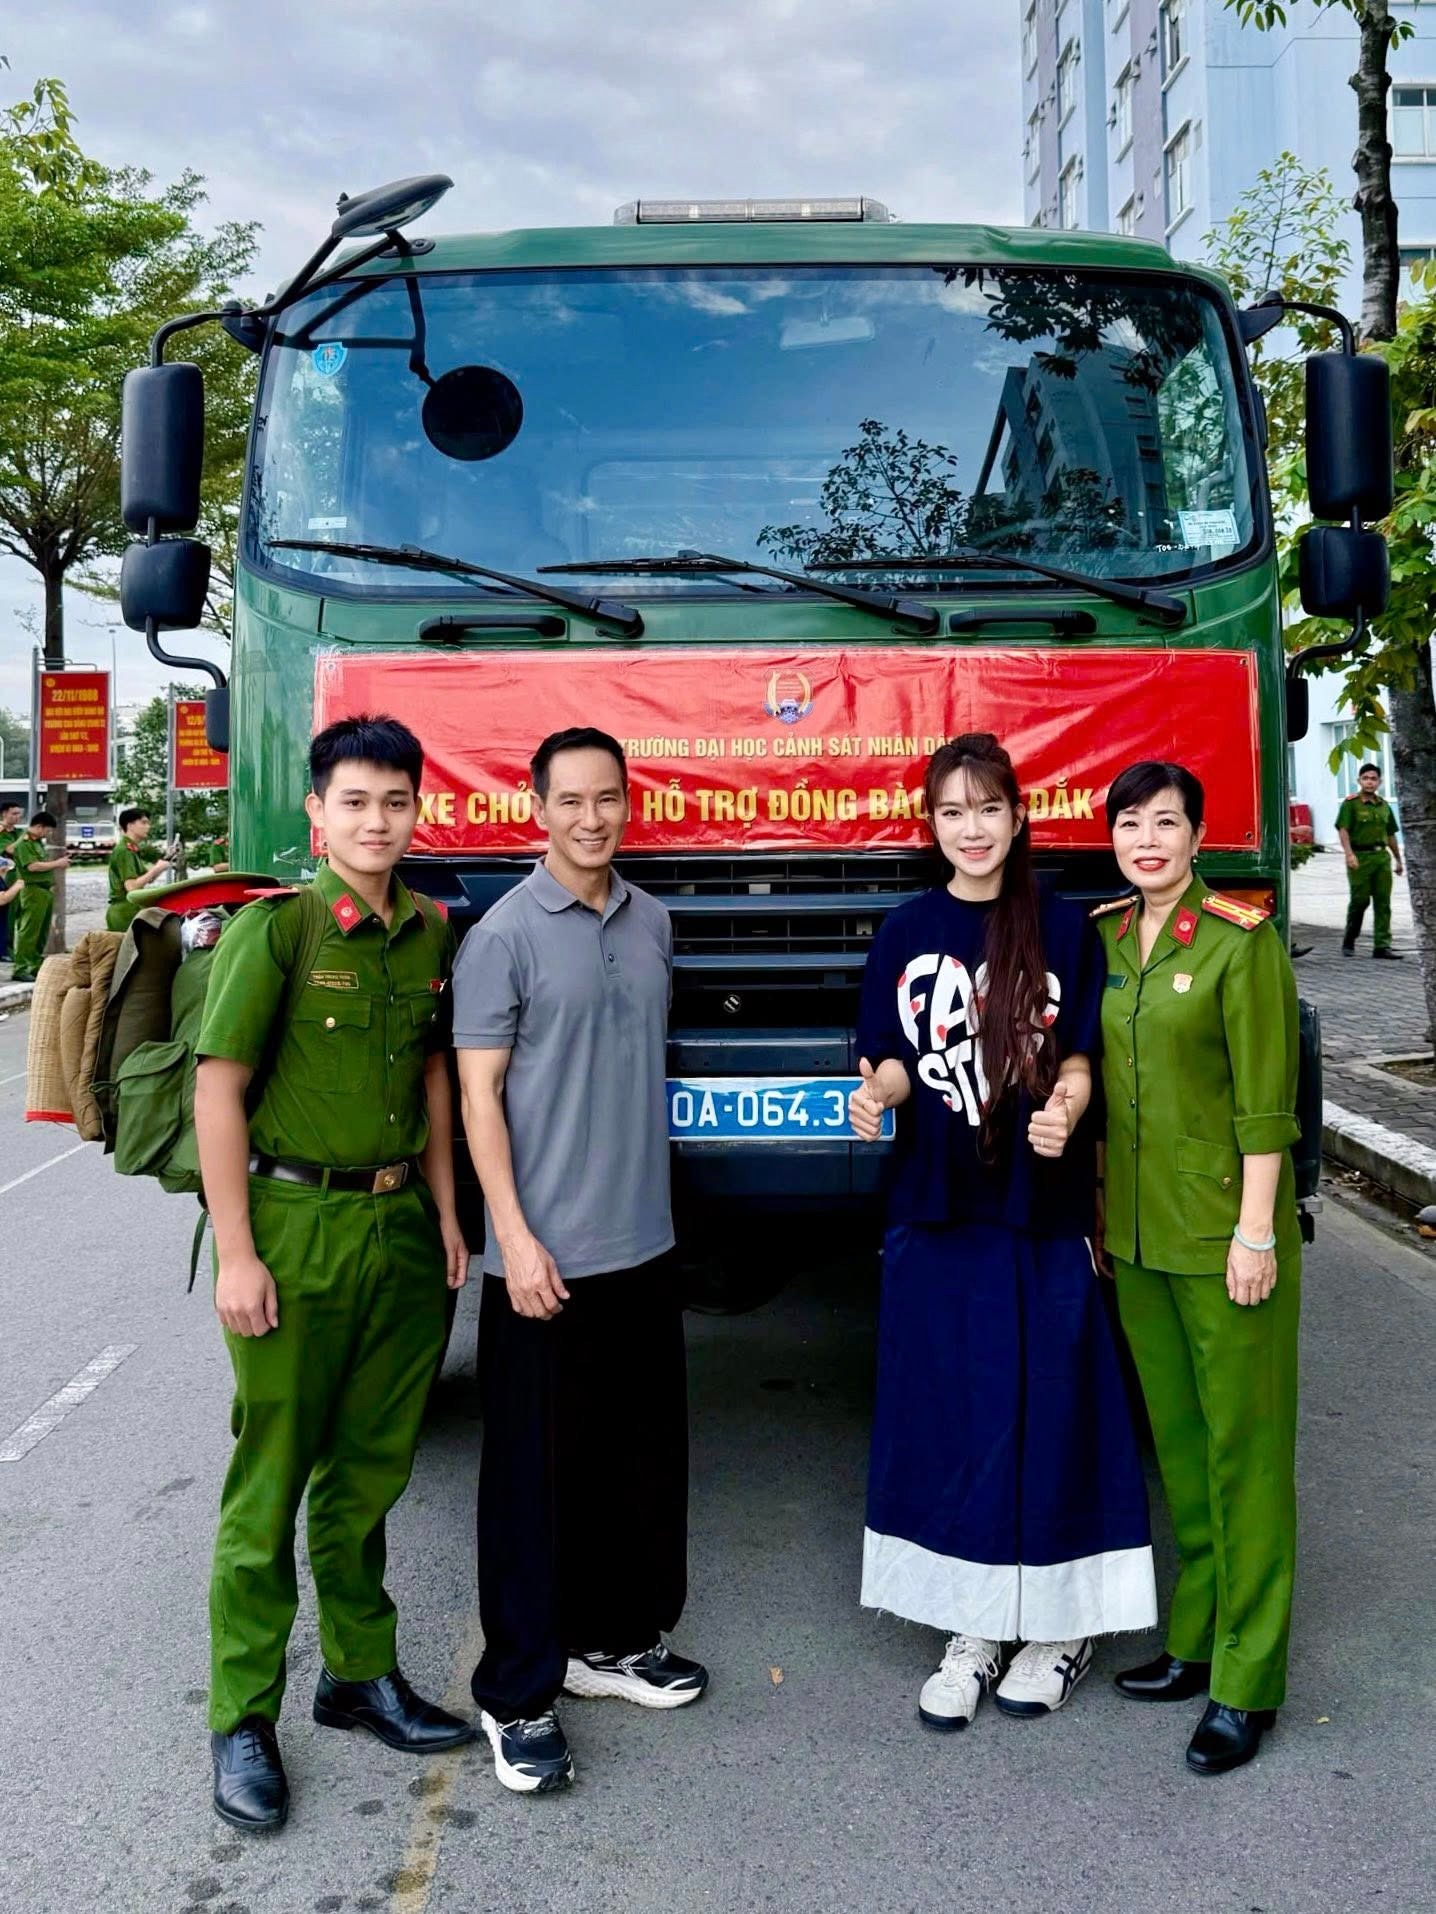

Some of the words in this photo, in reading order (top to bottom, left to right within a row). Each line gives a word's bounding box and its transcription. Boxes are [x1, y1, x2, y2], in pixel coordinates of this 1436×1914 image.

[695, 737, 725, 760] ĐẠI
[731, 737, 767, 760] HỌC
[773, 732, 823, 757] CẢNH
[829, 733, 862, 756] SÁT
[868, 734, 919, 756] NHÂN
[416, 792, 456, 825] XE
[467, 780, 533, 825] CHỞ
[643, 777, 686, 822] HỖ
[695, 786, 758, 828] TRỢ
[767, 777, 858, 821] ĐỒNG
[1028, 776, 1094, 819] ĐẮK
[667, 1090, 853, 1128] 0A-064.3
